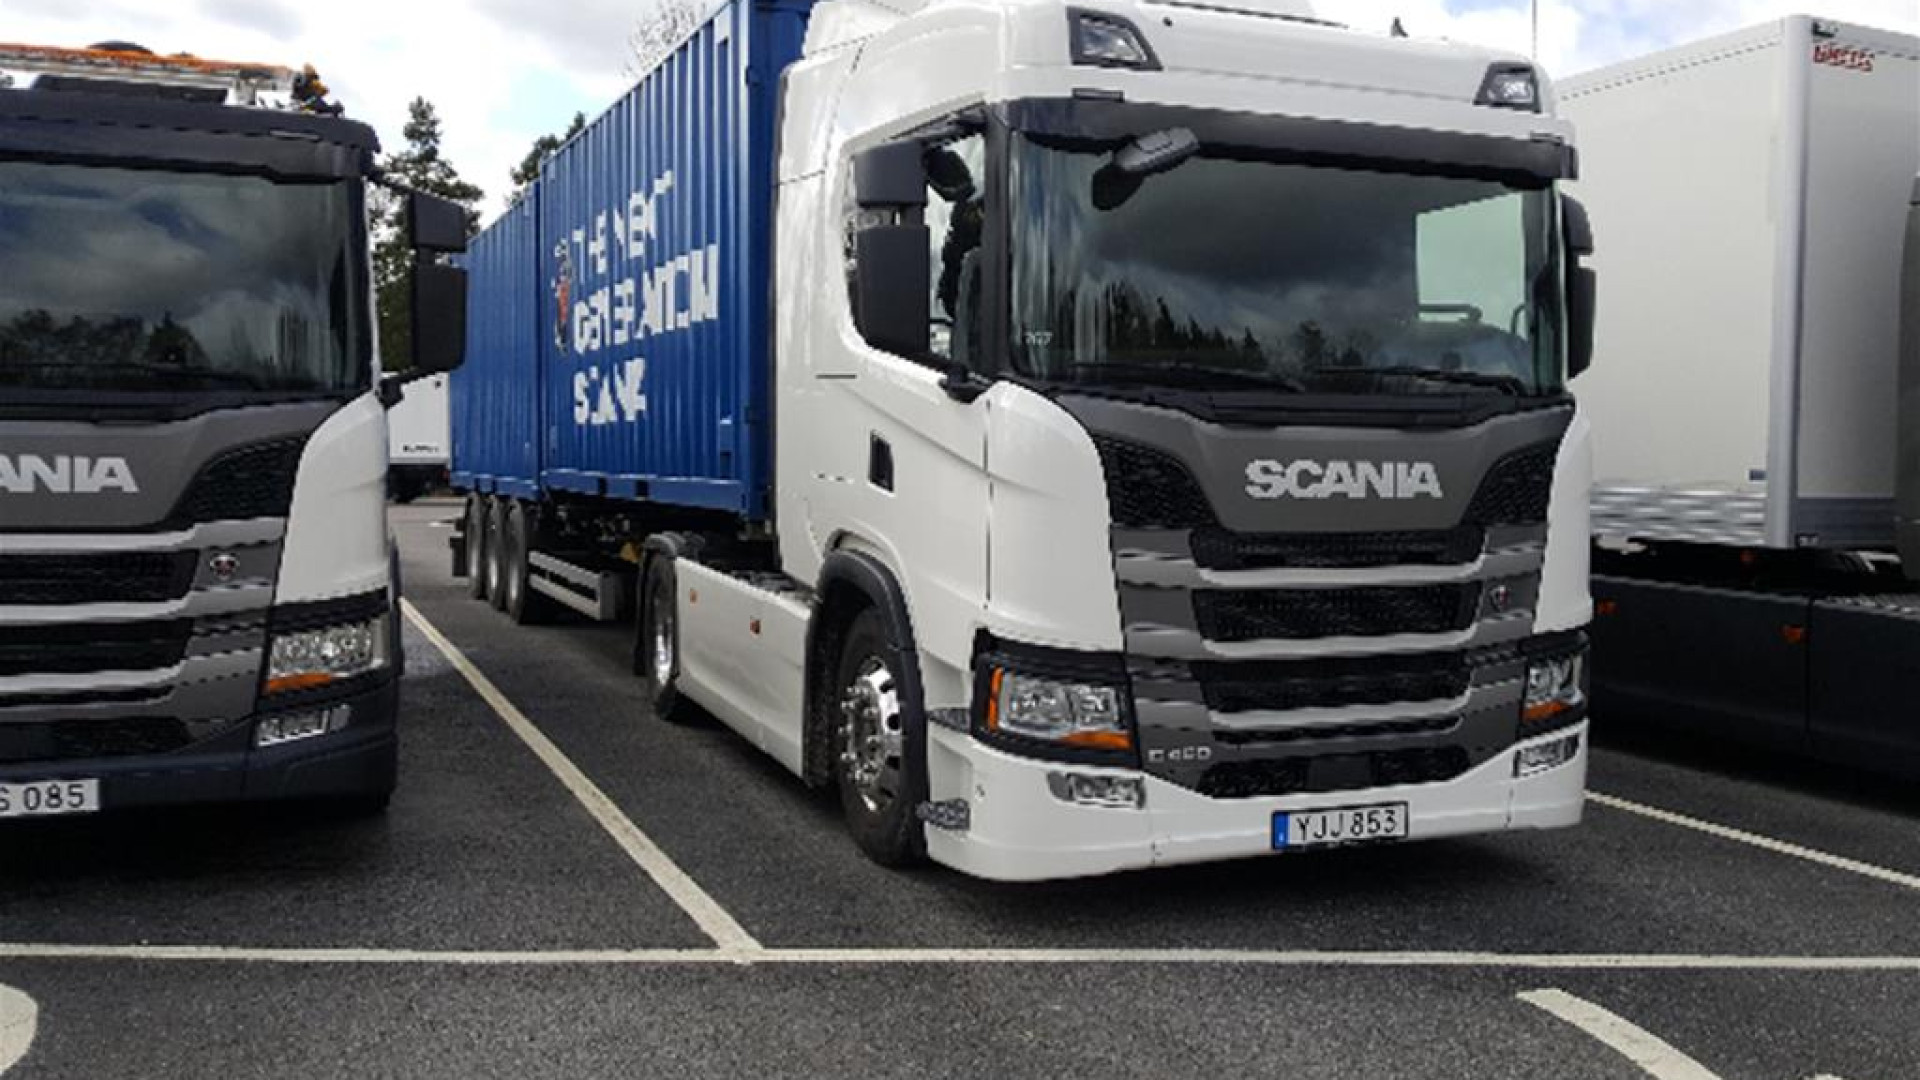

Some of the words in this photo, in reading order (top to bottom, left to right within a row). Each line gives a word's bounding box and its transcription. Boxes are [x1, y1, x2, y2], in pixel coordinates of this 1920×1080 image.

[1244, 459, 1443, 499] SCANIA
[23, 783, 84, 811] 085
[1296, 812, 1344, 841] YJJ
[1349, 809, 1397, 837] 853
